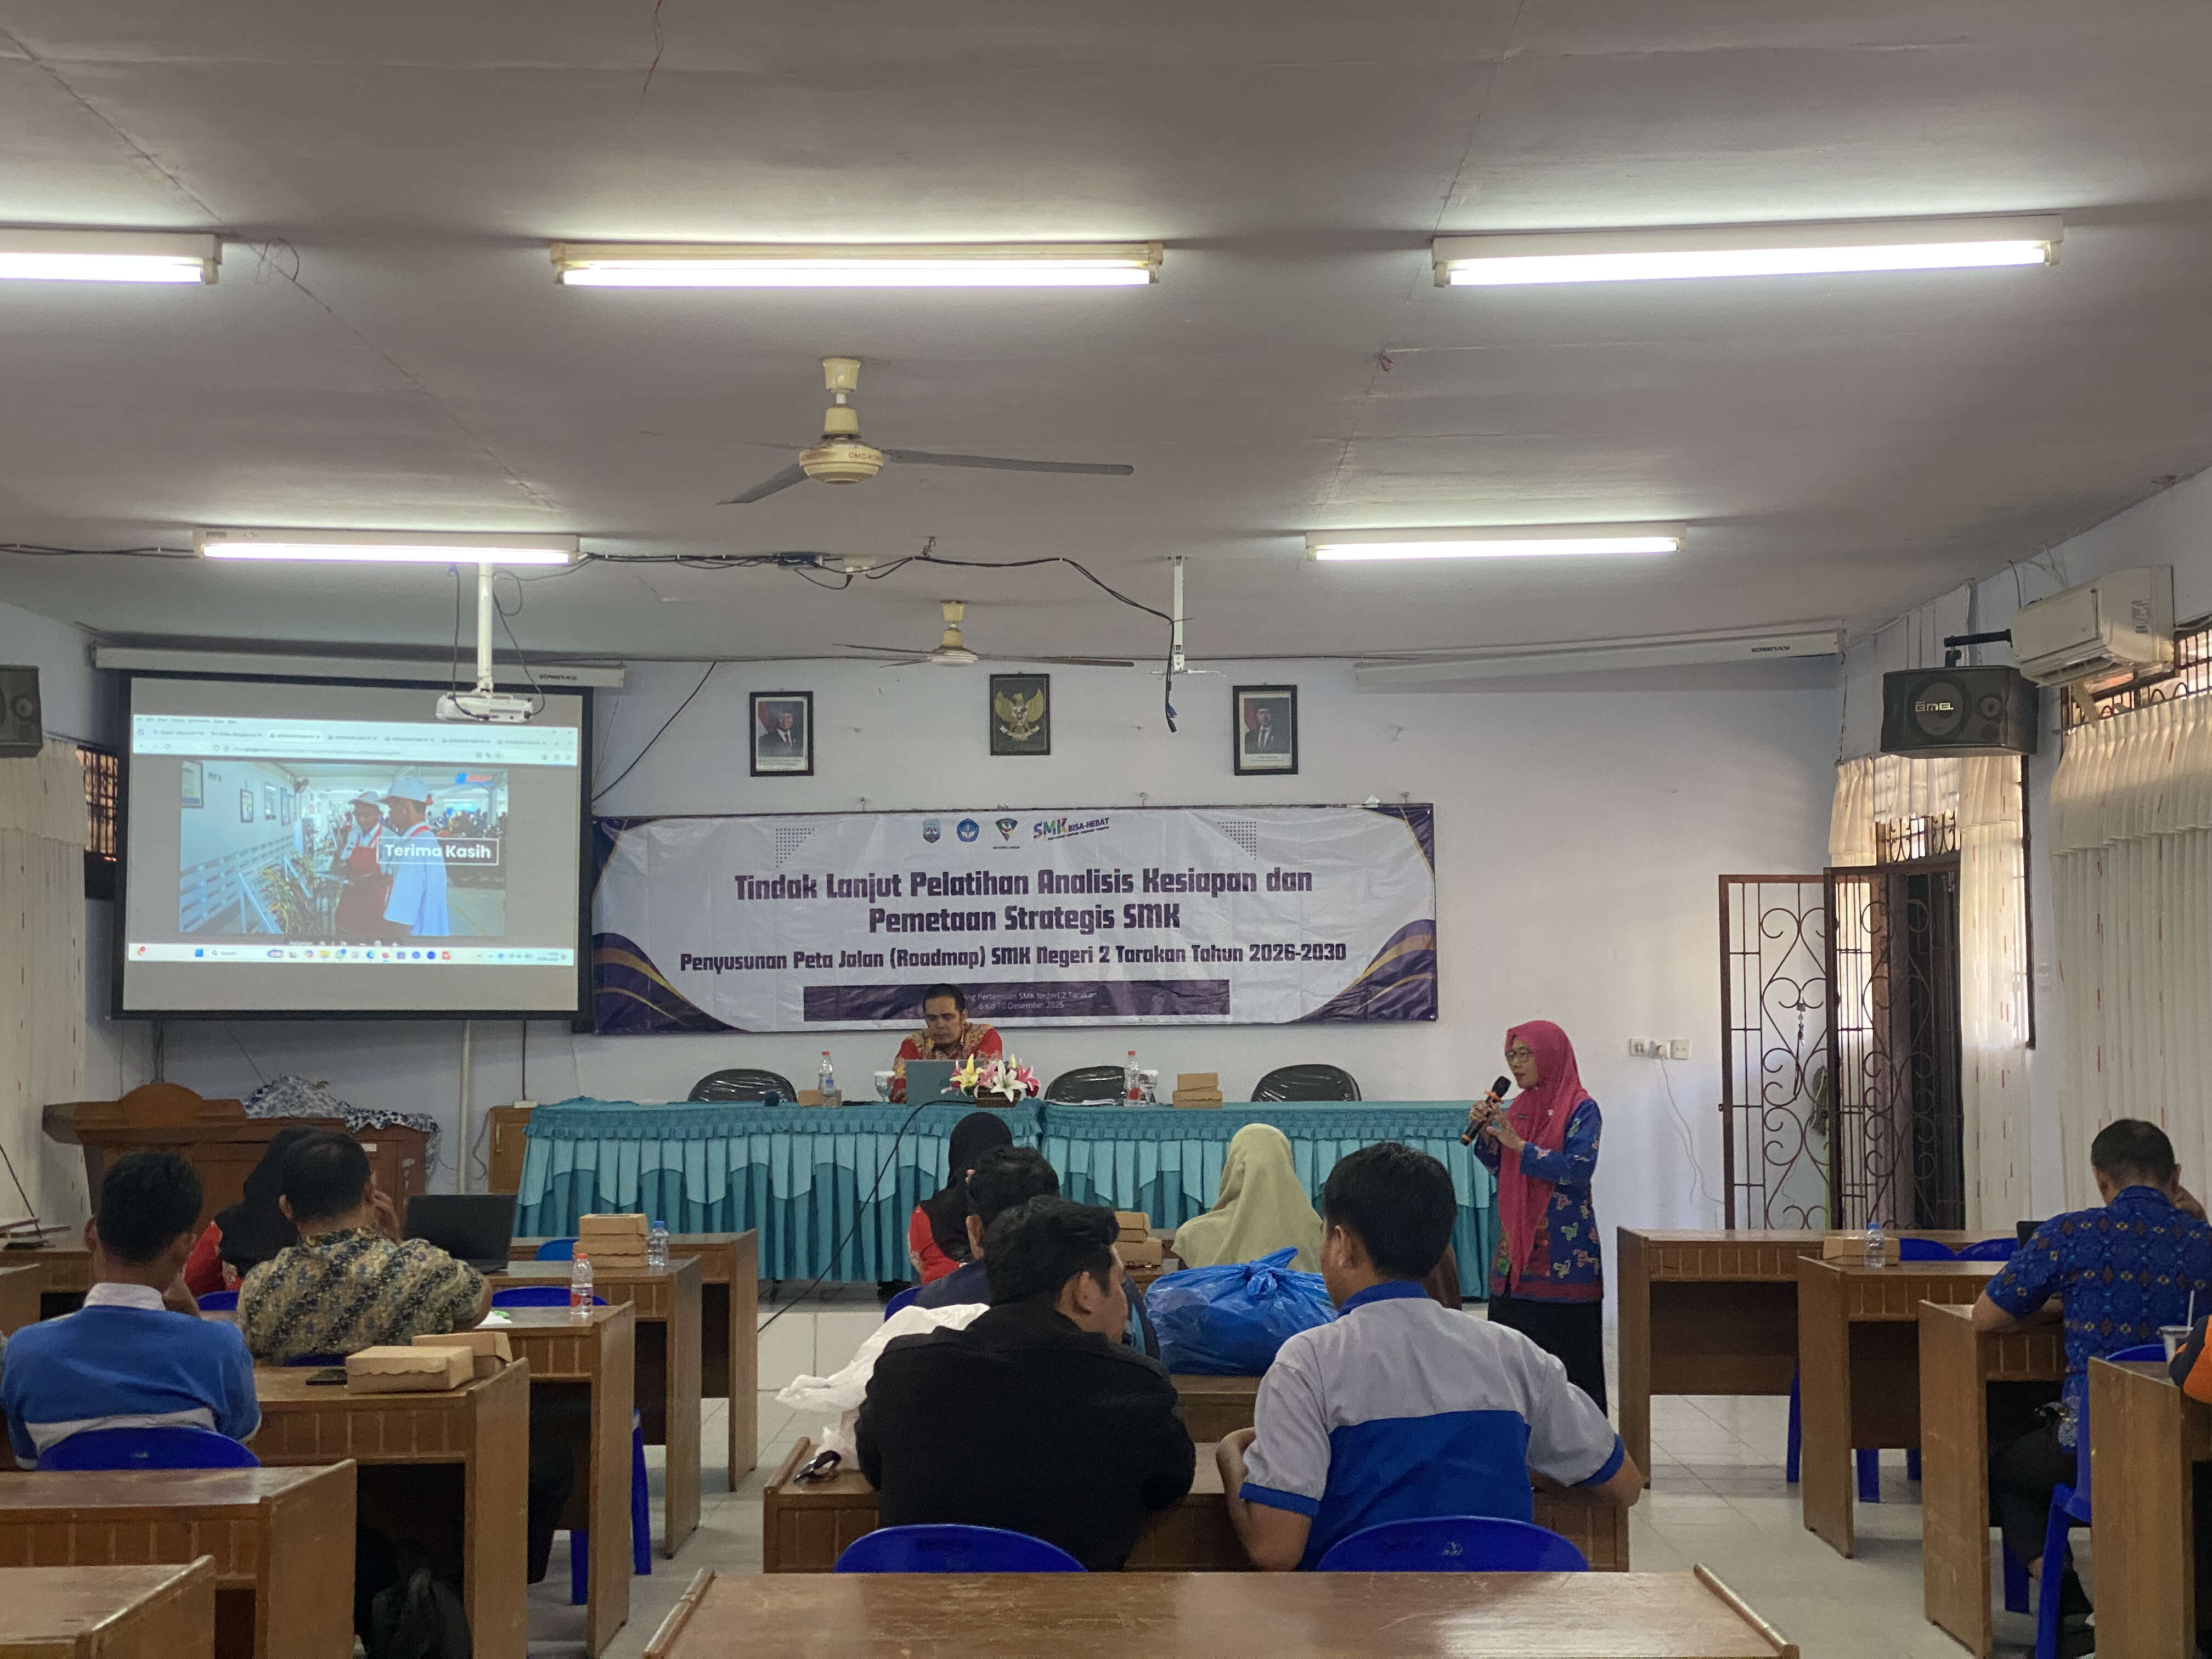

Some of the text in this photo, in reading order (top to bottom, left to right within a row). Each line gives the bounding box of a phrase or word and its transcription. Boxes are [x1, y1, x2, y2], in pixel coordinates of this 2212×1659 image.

[1033, 817, 1067, 839] SMK
[1068, 817, 1109, 832] BISA-HEBAT
[385, 844, 492, 858] Terima Kasih
[734, 867, 1312, 904] Tindak Lanjut Pelatihan Analisis Kesiapan dan
[869, 903, 1181, 935] Pemetaan Strategis SMK
[680, 943, 1346, 975] Penyusunan Peta Jalan (Roadmap) SMK Negeri 2 Tarakan Tahun 2026-2030
[1036, 992, 1060, 1001] Negeri
